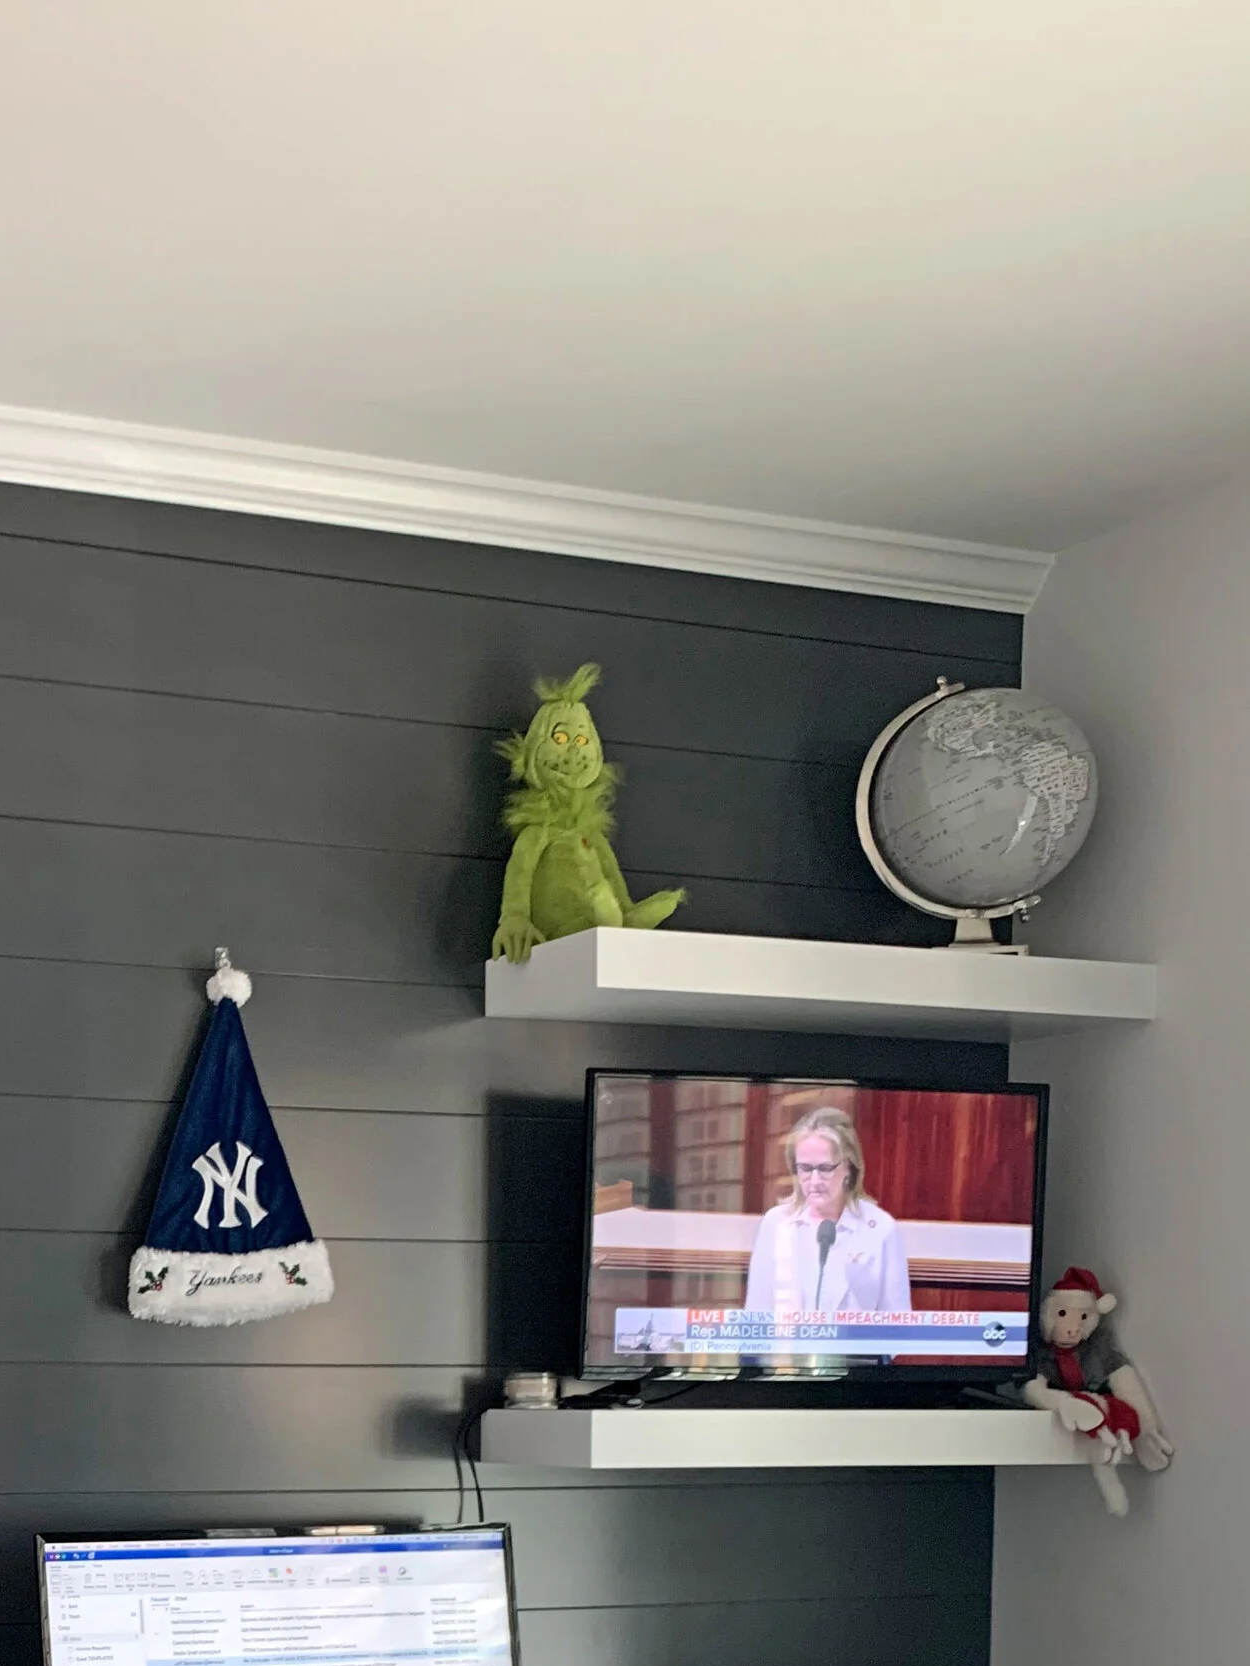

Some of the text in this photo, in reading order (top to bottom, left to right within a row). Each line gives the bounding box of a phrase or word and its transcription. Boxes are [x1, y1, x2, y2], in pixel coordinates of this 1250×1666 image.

[191, 1140, 270, 1230] NY
[185, 1265, 264, 1297] Yankees
[691, 1310, 980, 1325] LIVE NEWS HOUSE IMPEACHMENT DEBATE
[690, 1325, 838, 1340] Rep MADELEINE DEAN
[983, 1327, 1007, 1340] abc
